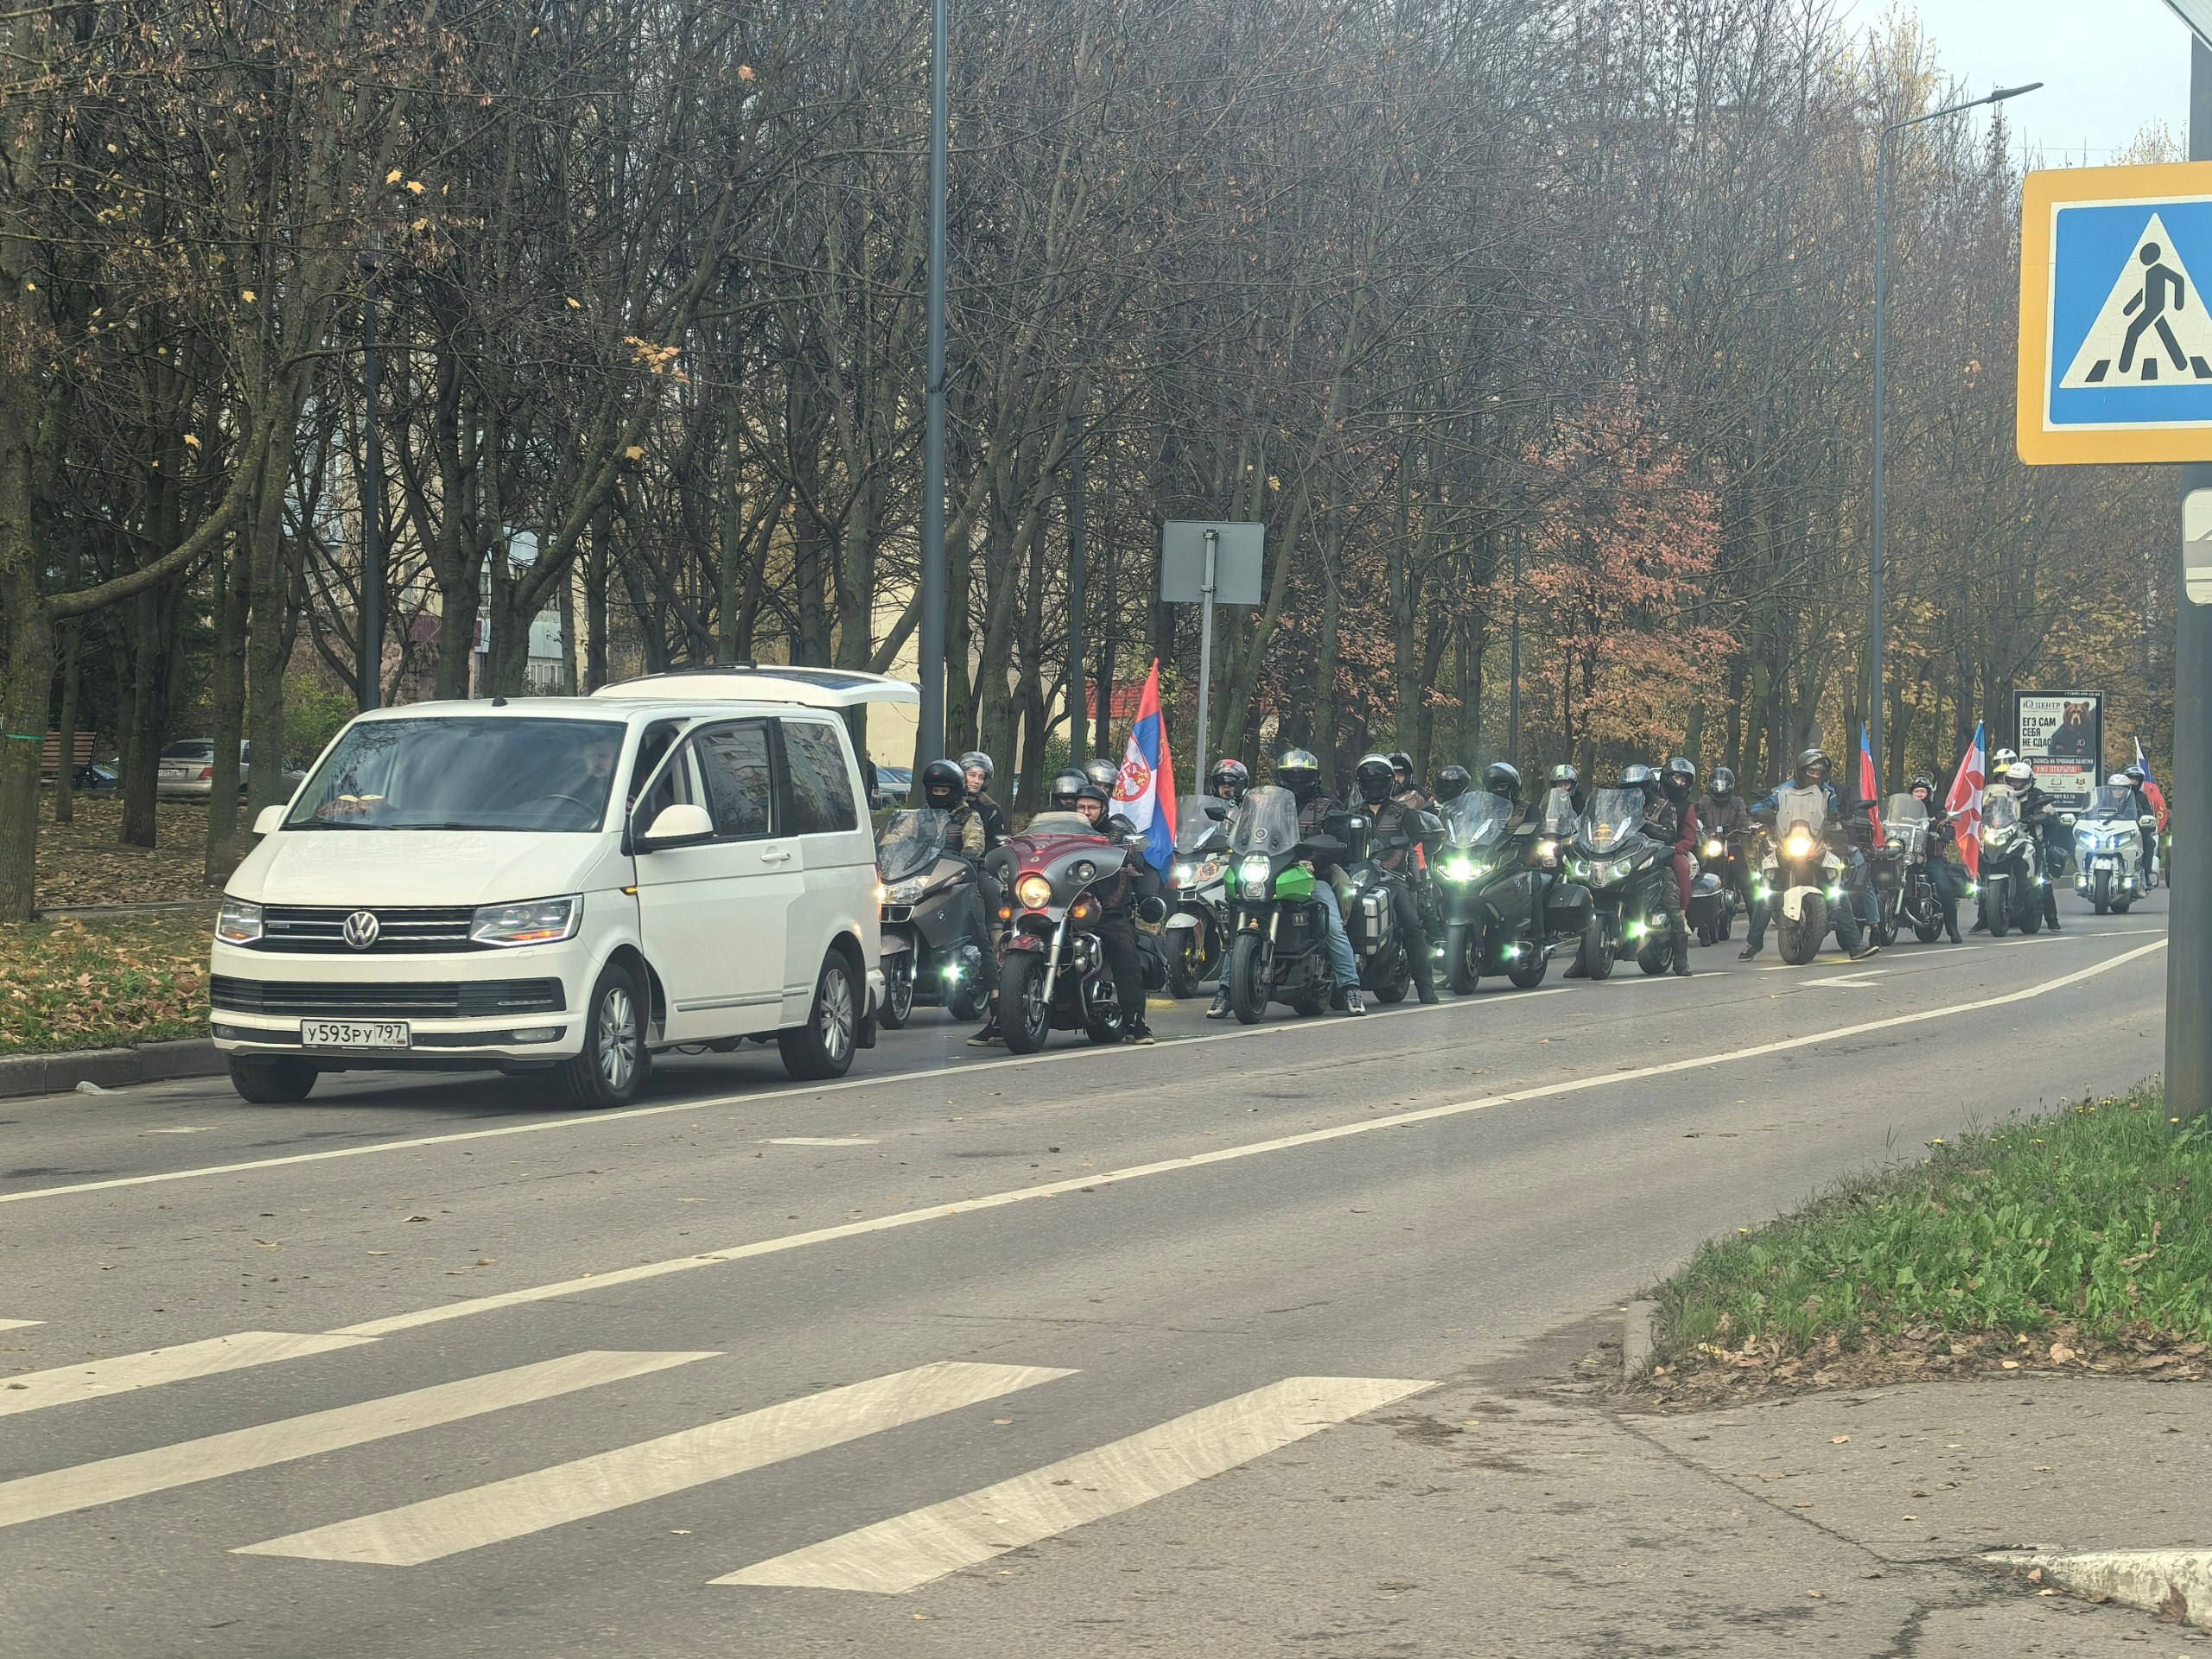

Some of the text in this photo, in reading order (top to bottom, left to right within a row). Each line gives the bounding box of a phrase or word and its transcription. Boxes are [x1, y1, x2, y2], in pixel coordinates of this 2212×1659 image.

[2023, 717, 2056, 727] ЕГЭ САМ
[2023, 728, 2041, 737] СЕБЯ
[2023, 738, 2031, 747] НЕ
[375, 1025, 402, 1039] 797
